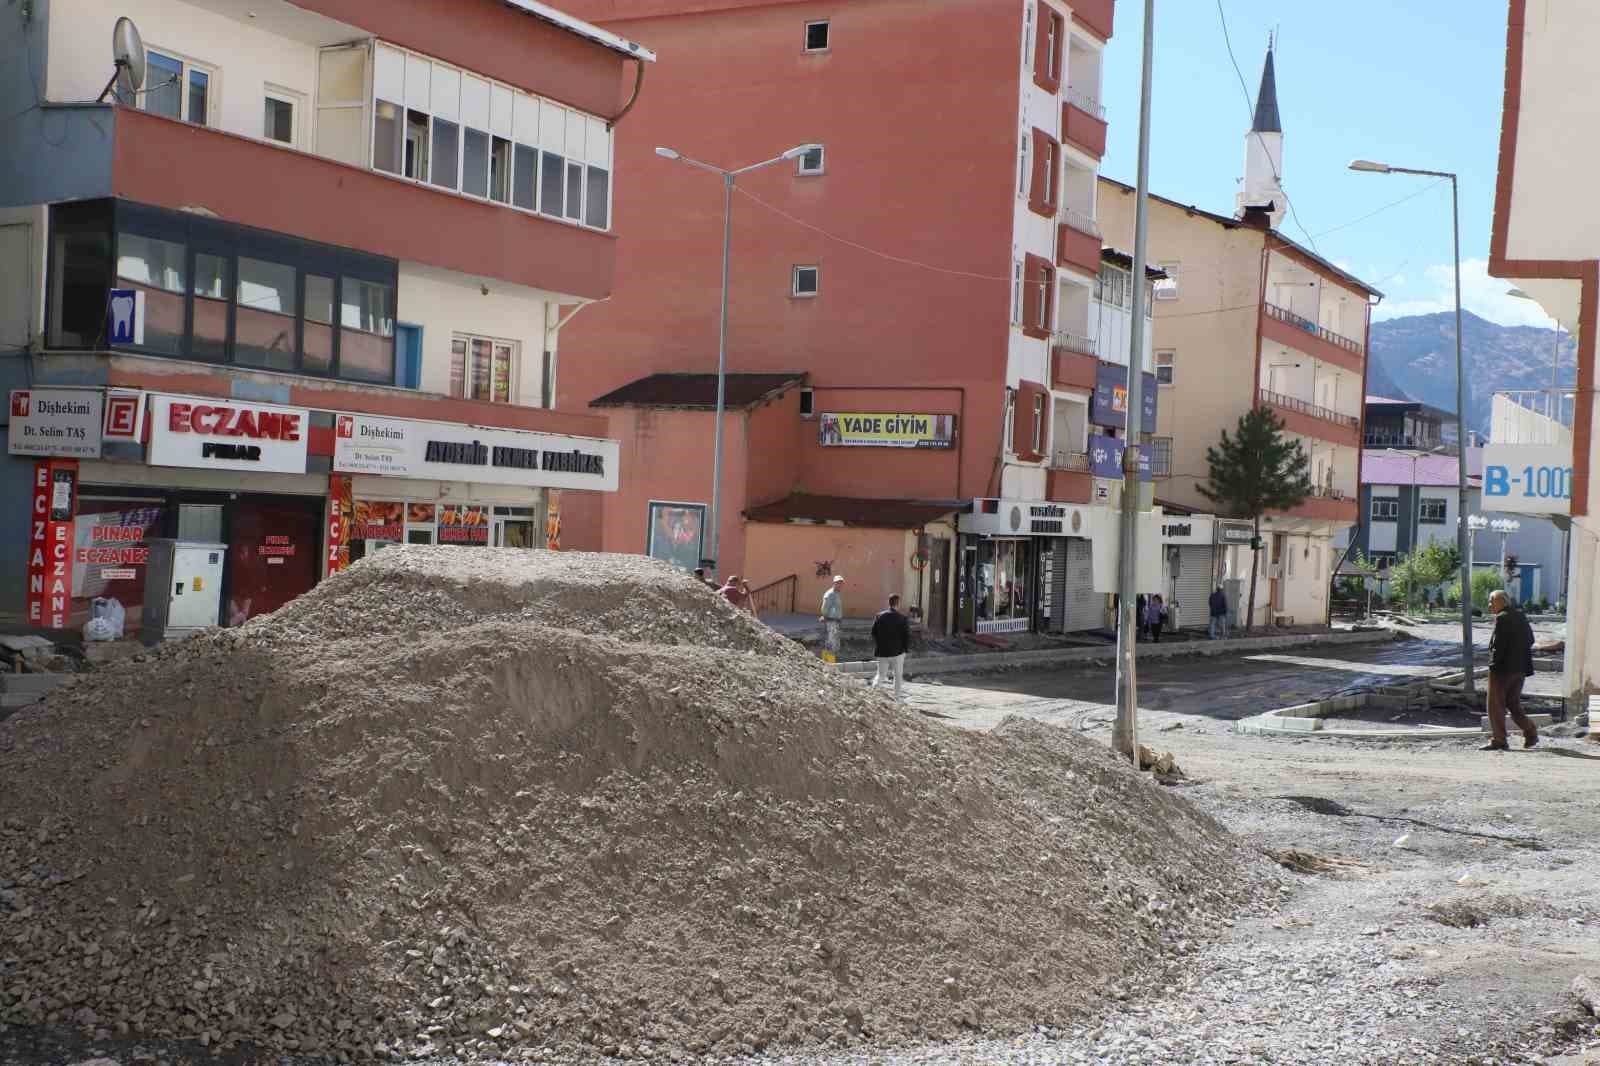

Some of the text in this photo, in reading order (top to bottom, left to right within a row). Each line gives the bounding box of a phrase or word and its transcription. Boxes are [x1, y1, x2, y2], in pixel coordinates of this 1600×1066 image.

[38, 400, 90, 416] Dişhekimi
[168, 403, 300, 441] ECZANE
[843, 414, 928, 435] YADE GİYİM
[40, 426, 64, 437] Selim
[65, 427, 86, 440] TAŞ
[31, 467, 48, 620] ECZANE
[91, 525, 144, 542] PINAR
[51, 526, 66, 629] ECZANE
